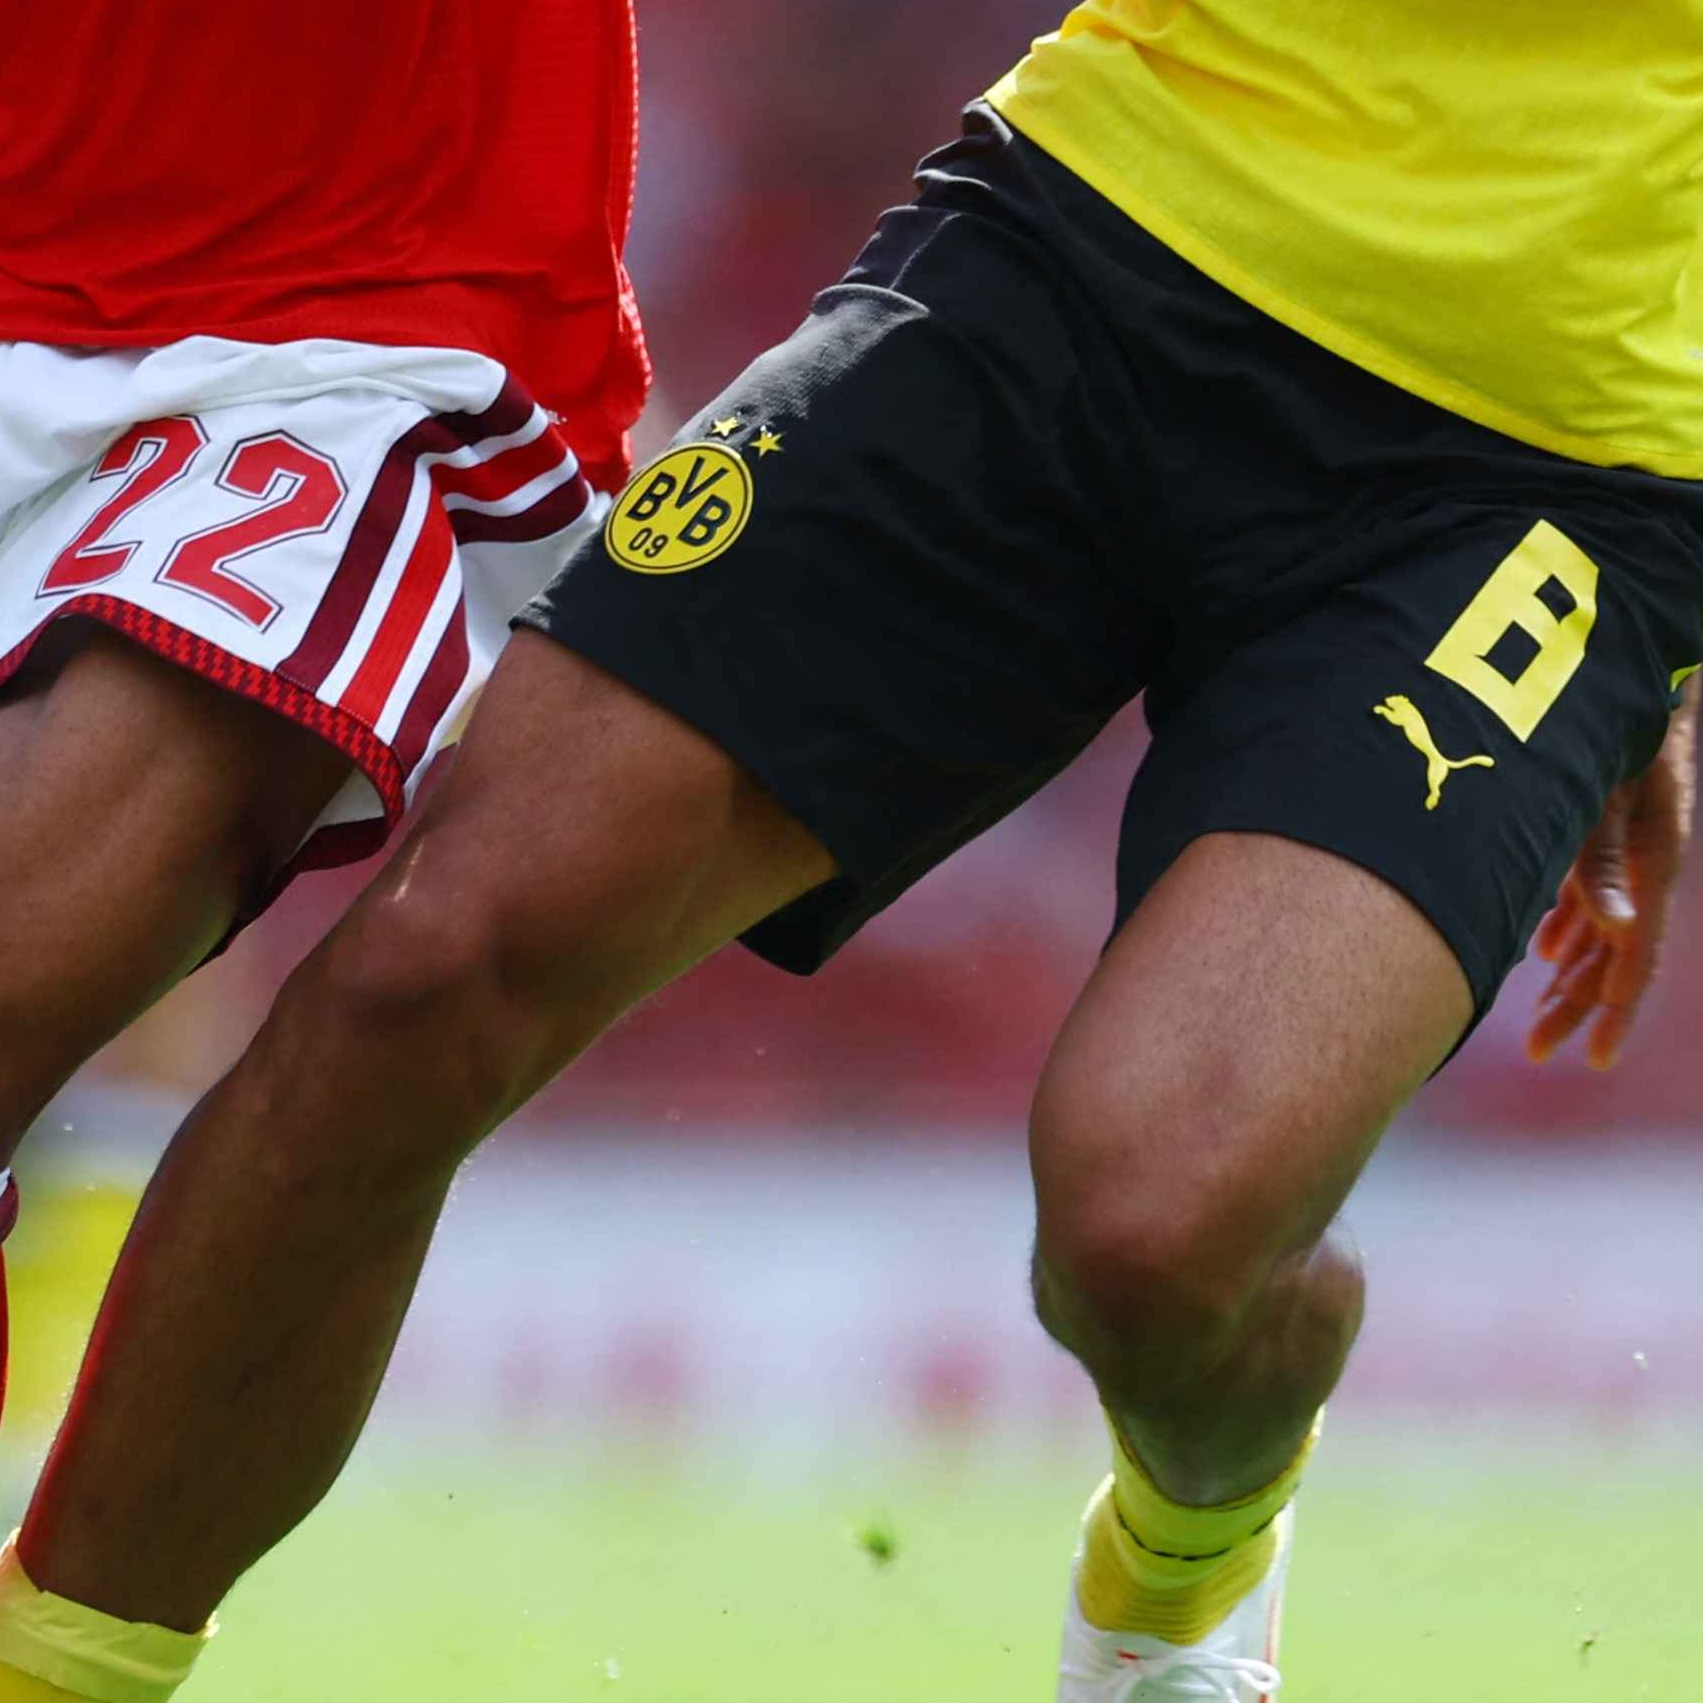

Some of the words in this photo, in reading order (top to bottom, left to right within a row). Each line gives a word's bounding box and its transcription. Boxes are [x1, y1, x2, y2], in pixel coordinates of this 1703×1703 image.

[36, 413, 349, 634] 22
[625, 455, 732, 547] BVB
[628, 526, 669, 559] 09
